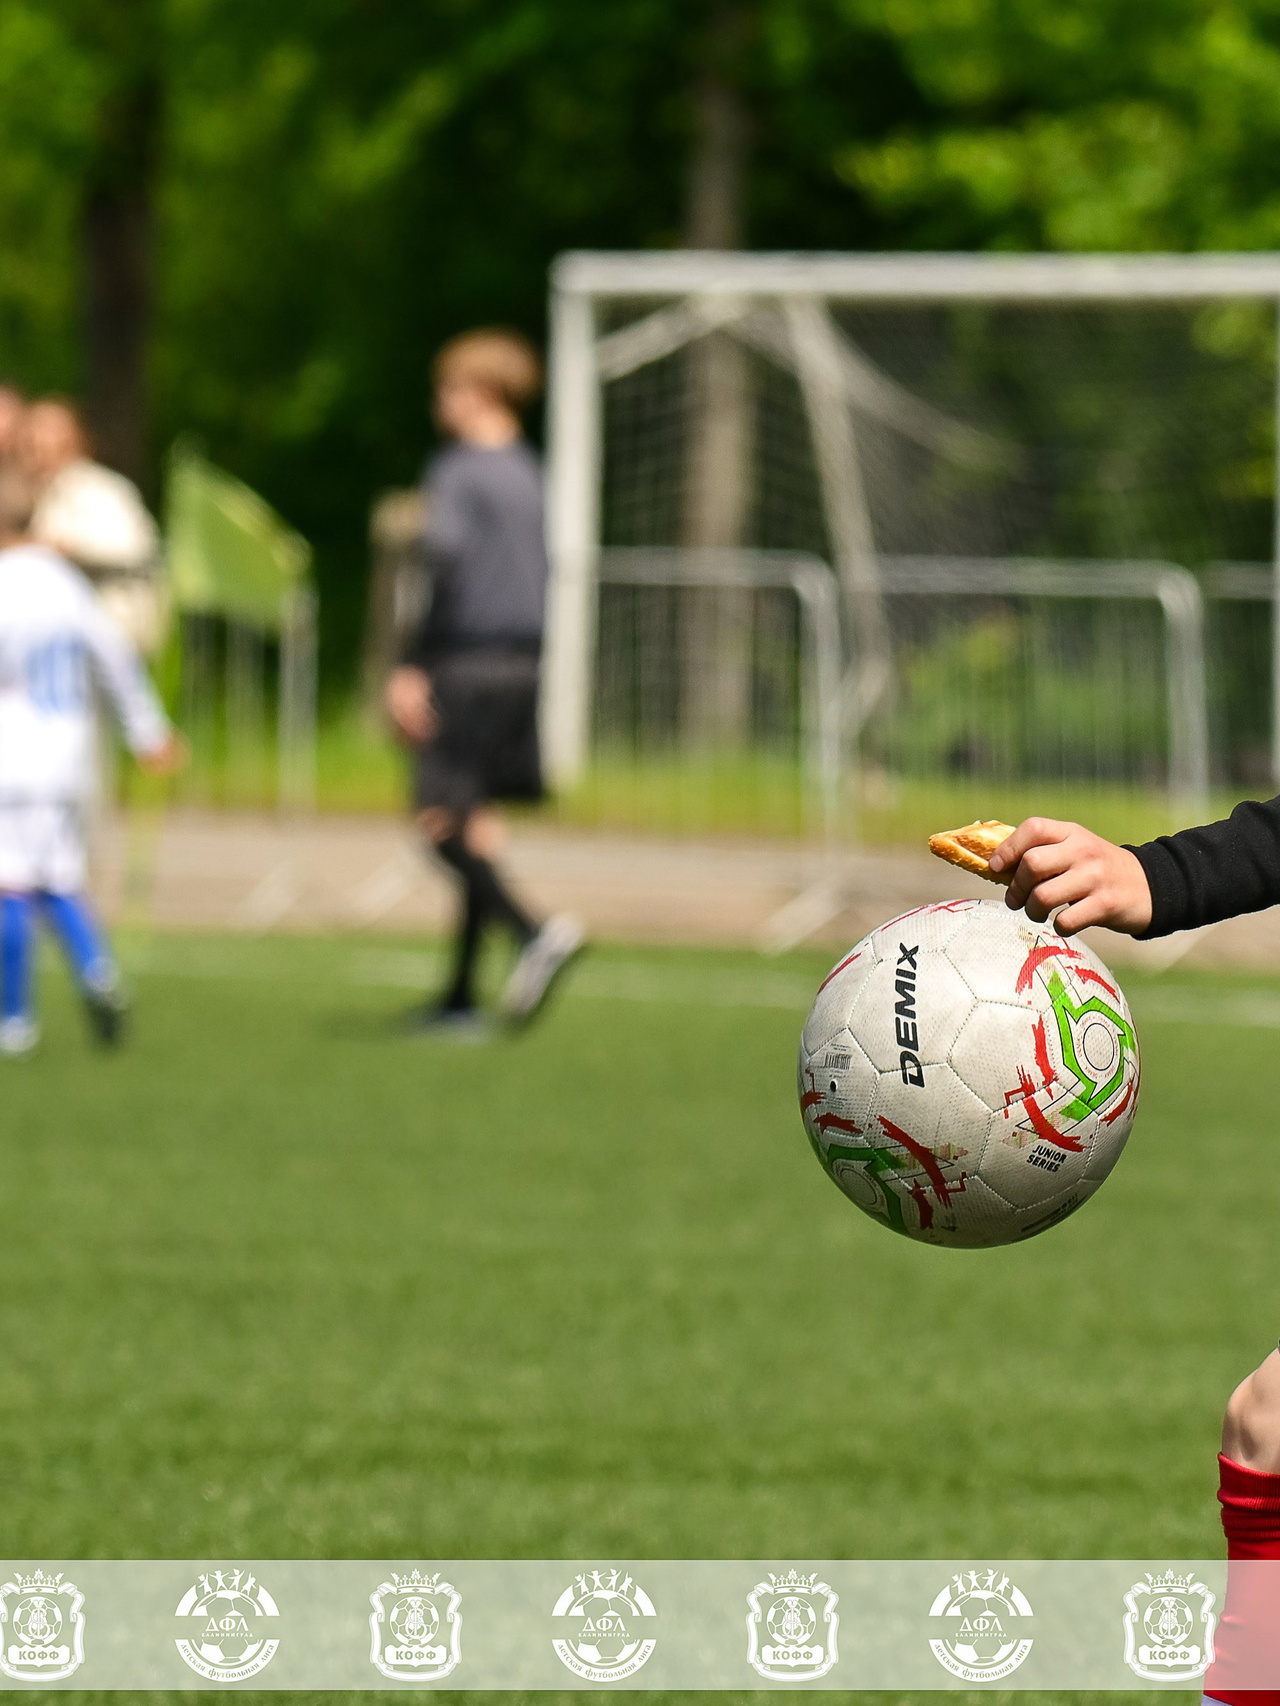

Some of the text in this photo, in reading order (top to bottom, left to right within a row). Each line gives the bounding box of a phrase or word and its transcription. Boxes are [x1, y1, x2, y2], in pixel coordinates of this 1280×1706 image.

[894, 942, 925, 1088] DEMIX
[1026, 1154, 1061, 1173] SERIES
[1032, 1145, 1067, 1164] JUNIOR
